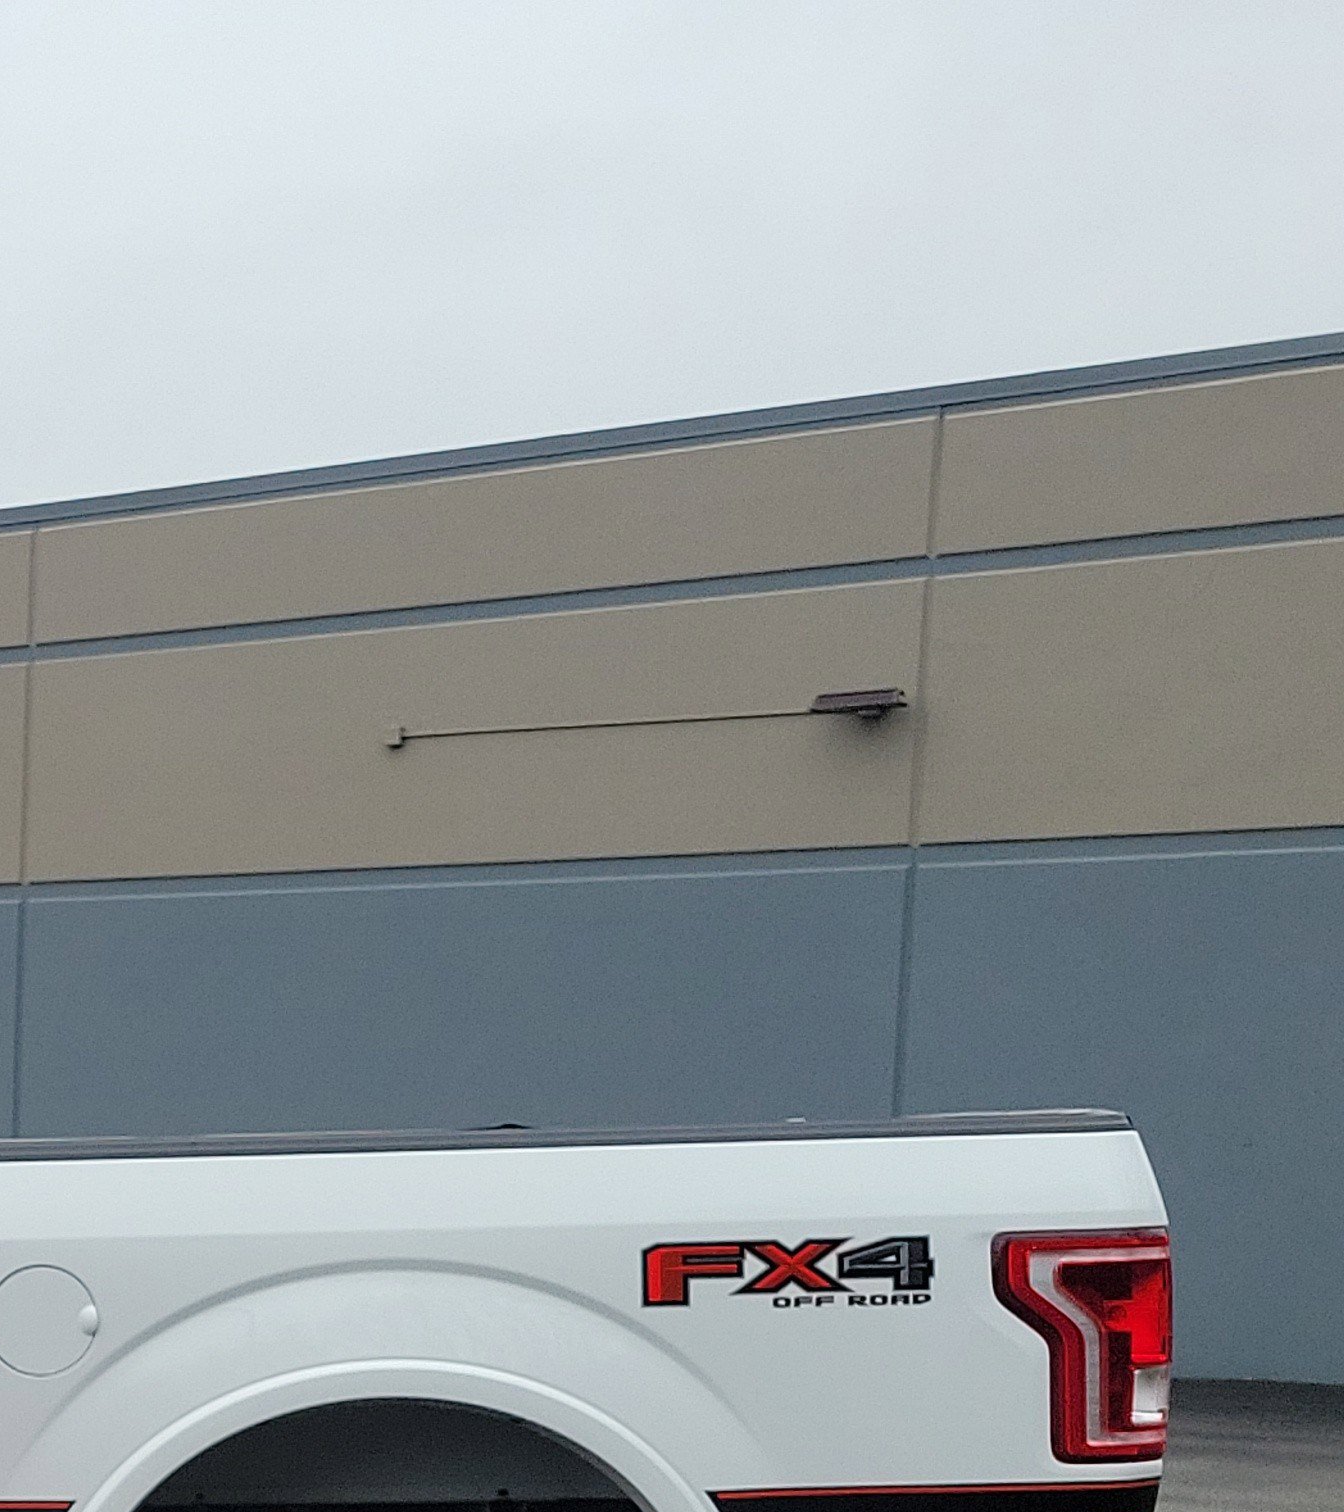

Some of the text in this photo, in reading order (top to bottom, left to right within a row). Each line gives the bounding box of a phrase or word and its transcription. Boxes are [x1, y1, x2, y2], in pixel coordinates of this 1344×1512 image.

[642, 1236, 933, 1307] FX4
[772, 1293, 932, 1308] OFF ROAD
